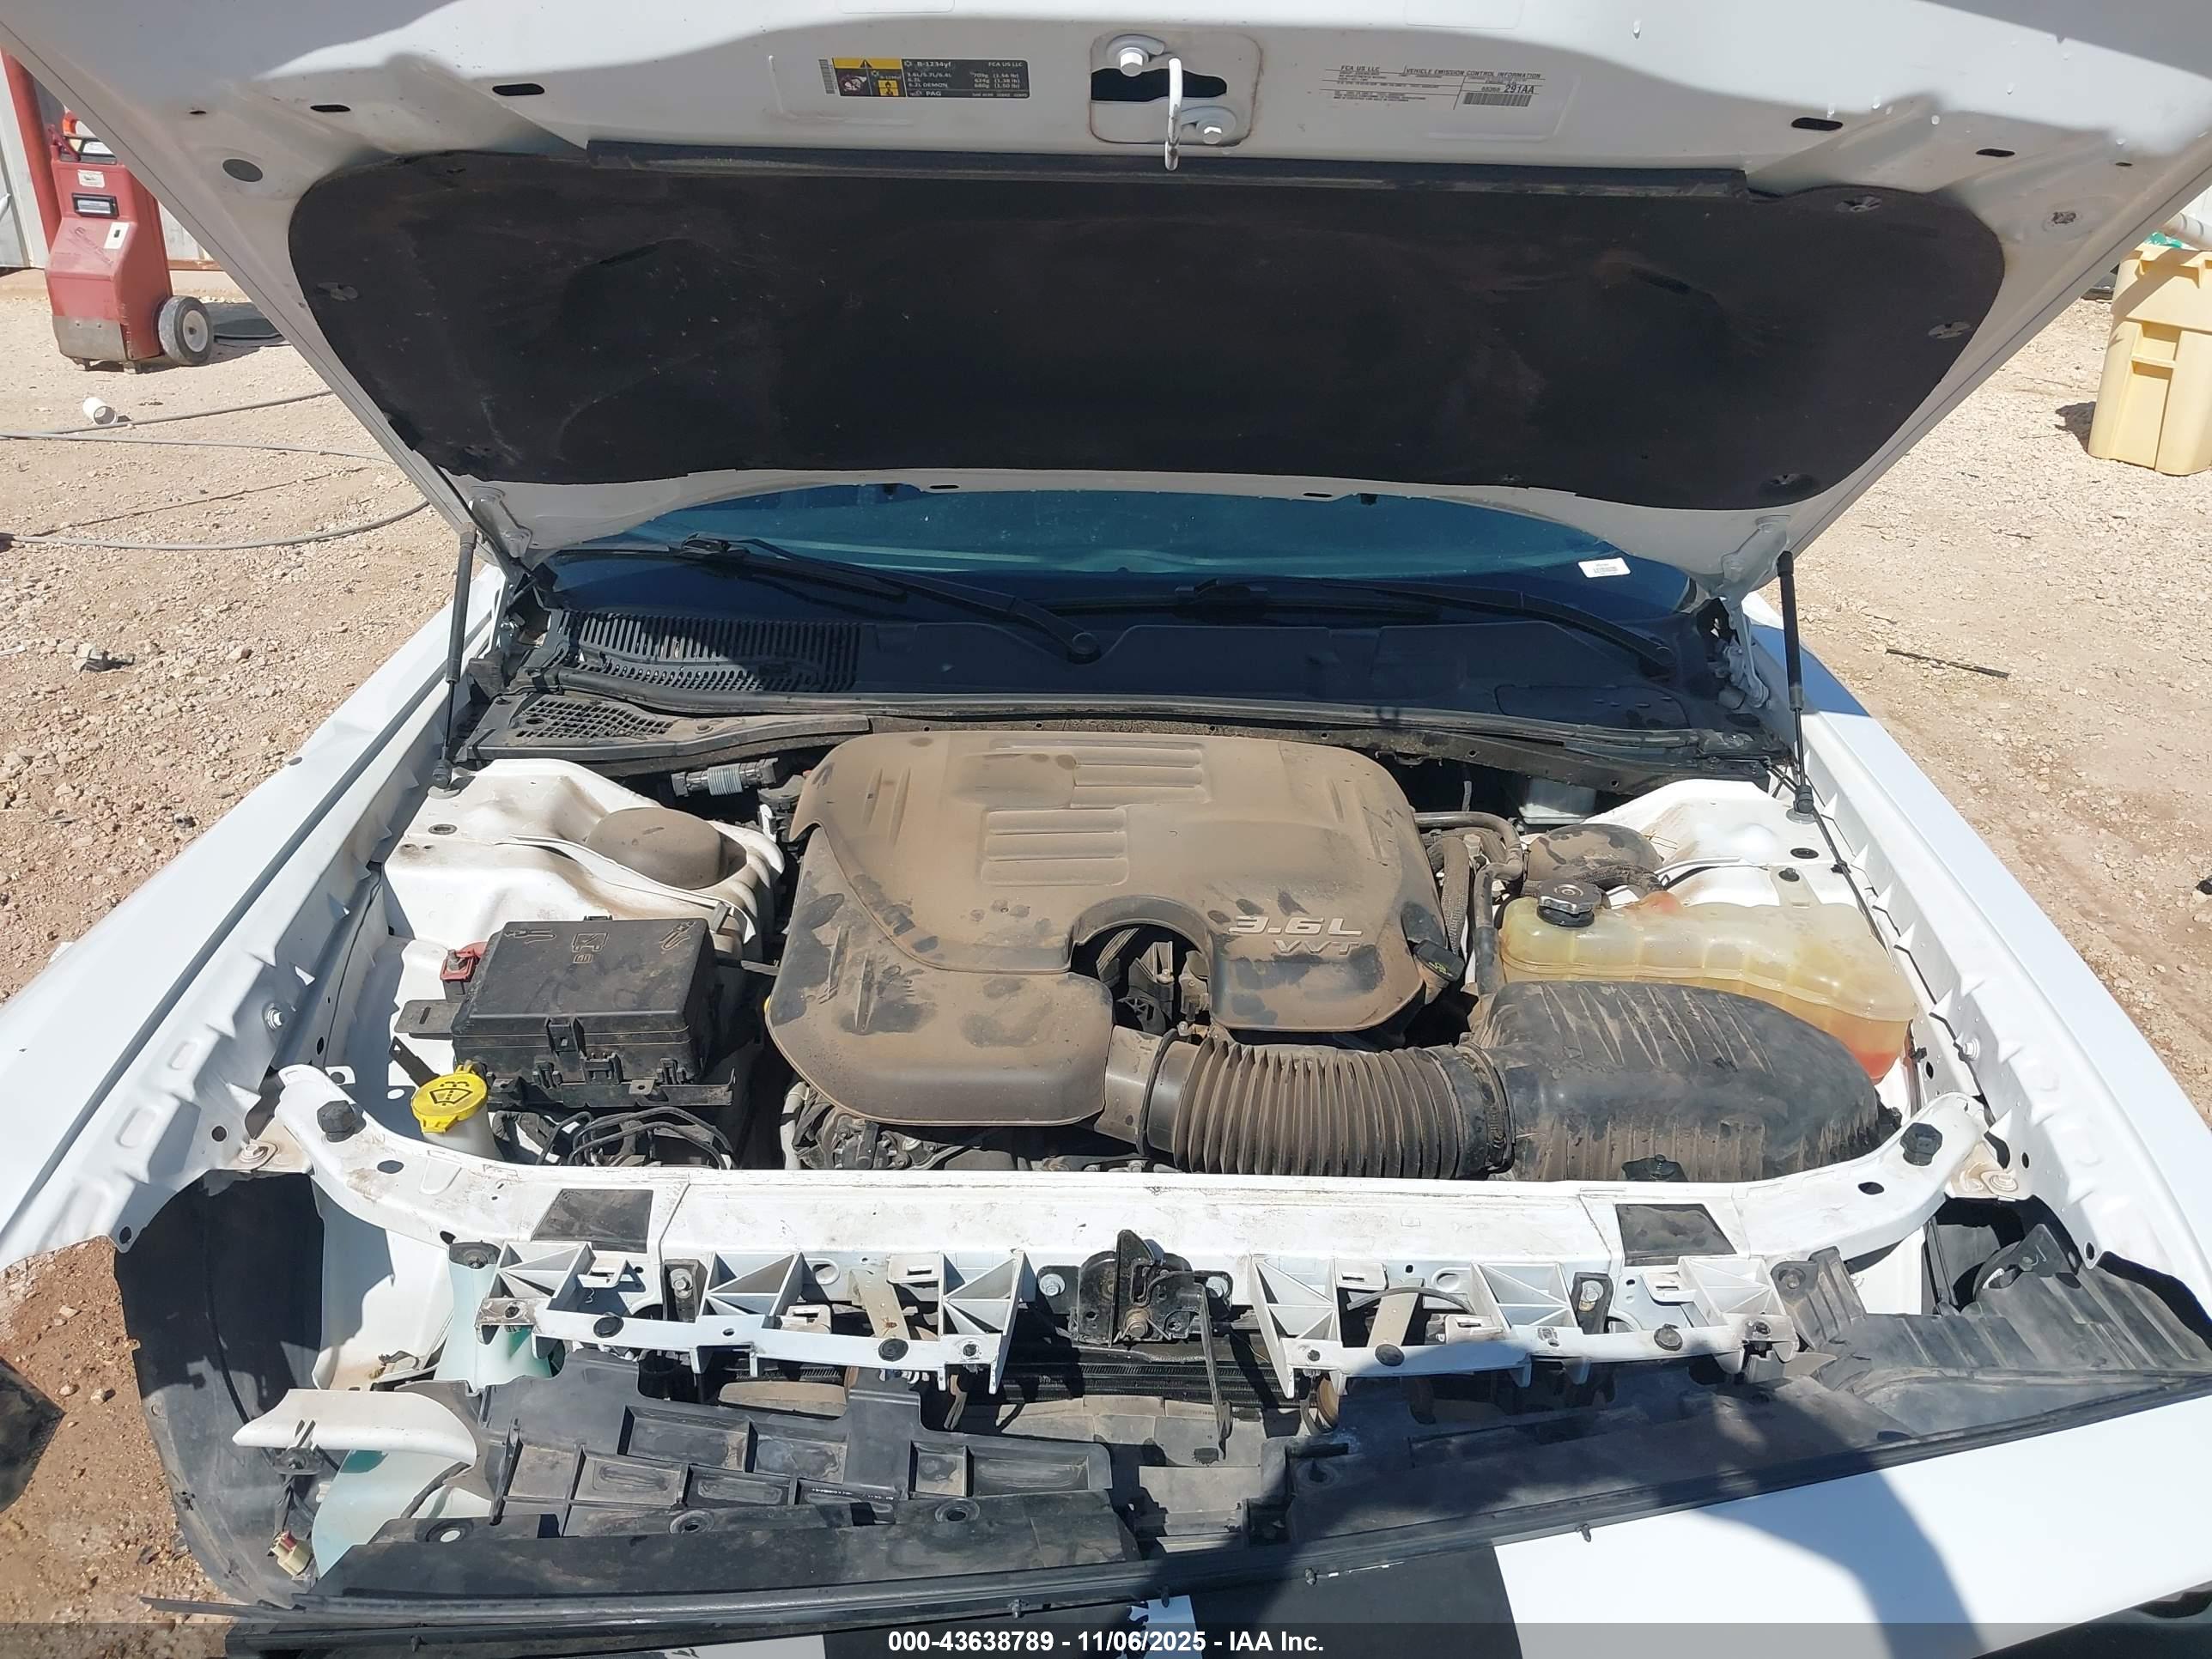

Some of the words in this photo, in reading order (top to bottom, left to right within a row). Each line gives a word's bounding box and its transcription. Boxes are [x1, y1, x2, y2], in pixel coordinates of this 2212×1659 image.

[1504, 84, 1534, 94] 291AA
[1228, 915, 1364, 936] 3.6L
[1273, 939, 1360, 955] VVT
